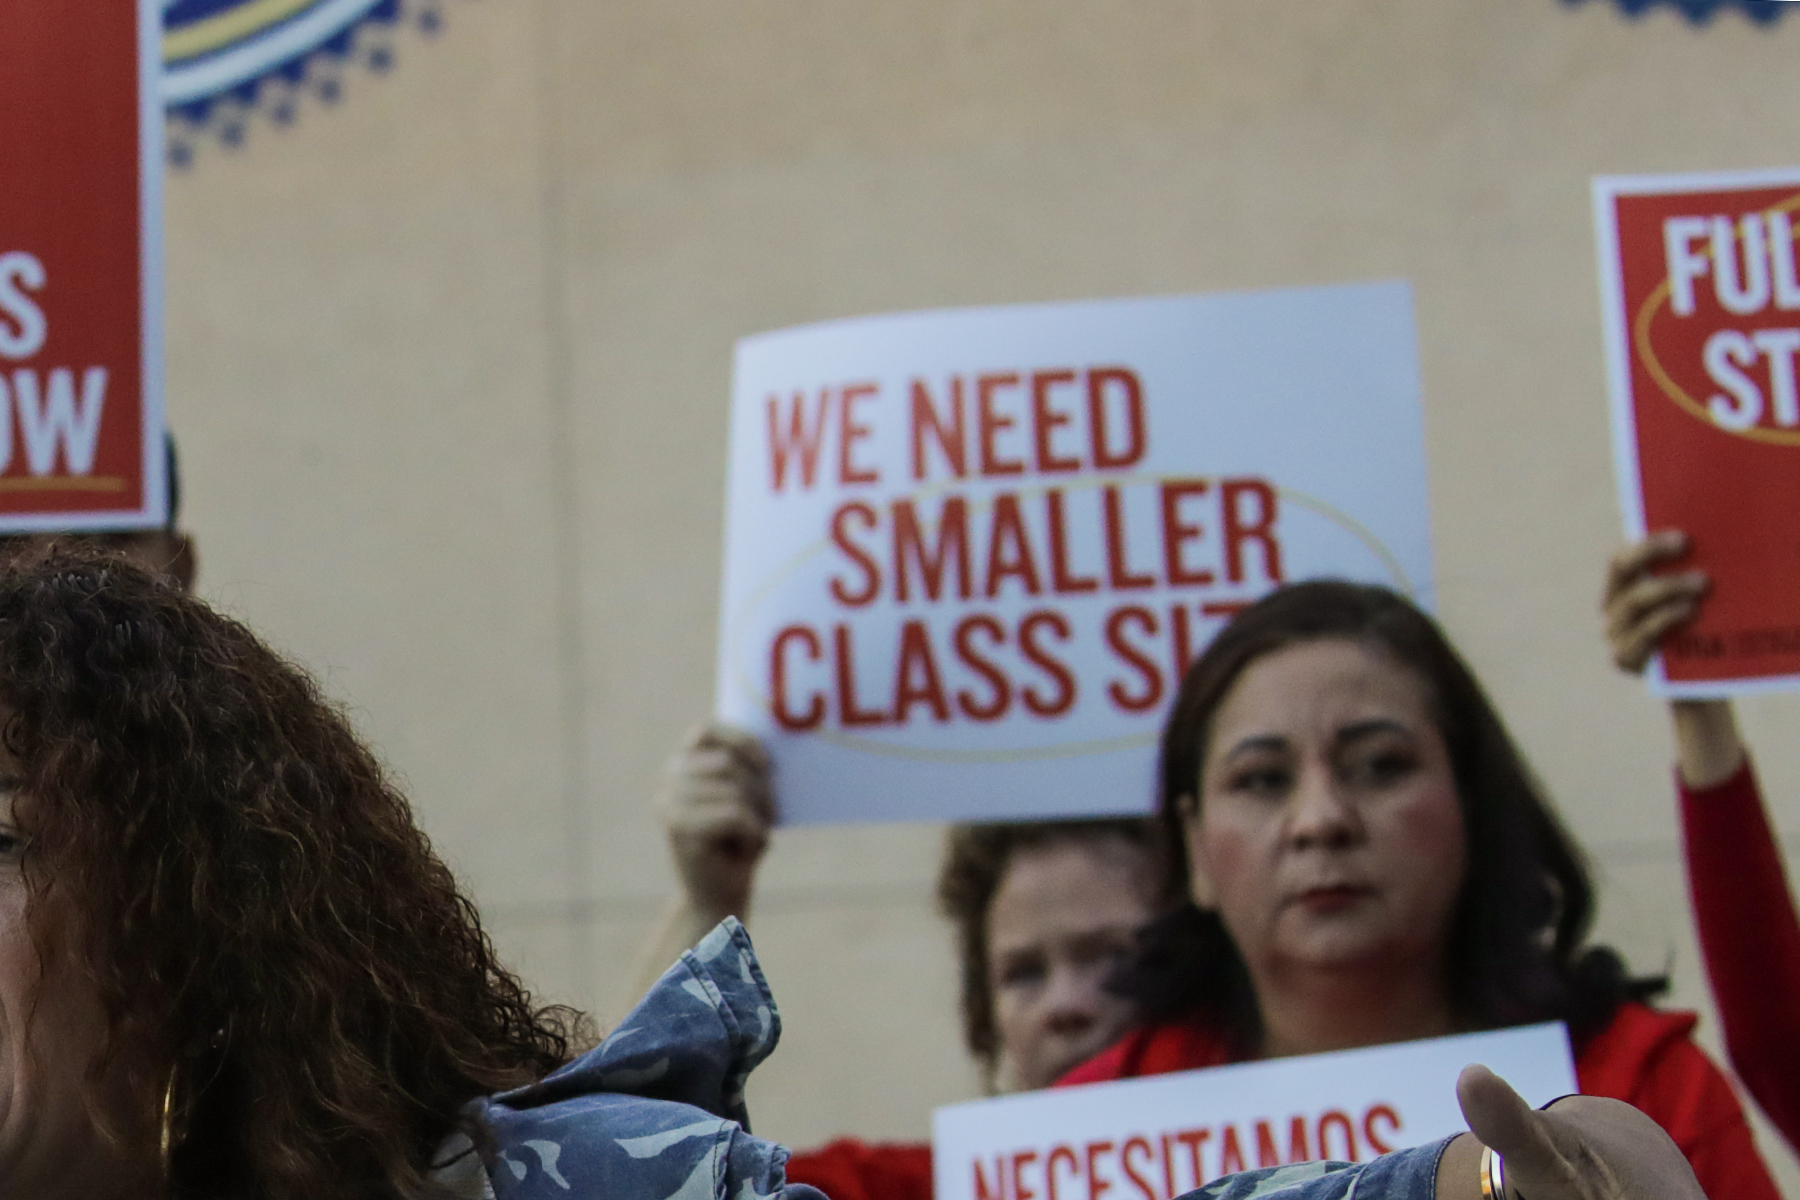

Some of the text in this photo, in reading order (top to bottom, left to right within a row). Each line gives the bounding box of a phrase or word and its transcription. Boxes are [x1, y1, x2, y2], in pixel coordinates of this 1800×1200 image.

[766, 365, 1148, 493] WE NEED
[829, 477, 1285, 610] SMALLER
[769, 602, 1242, 734] CLASS SI
